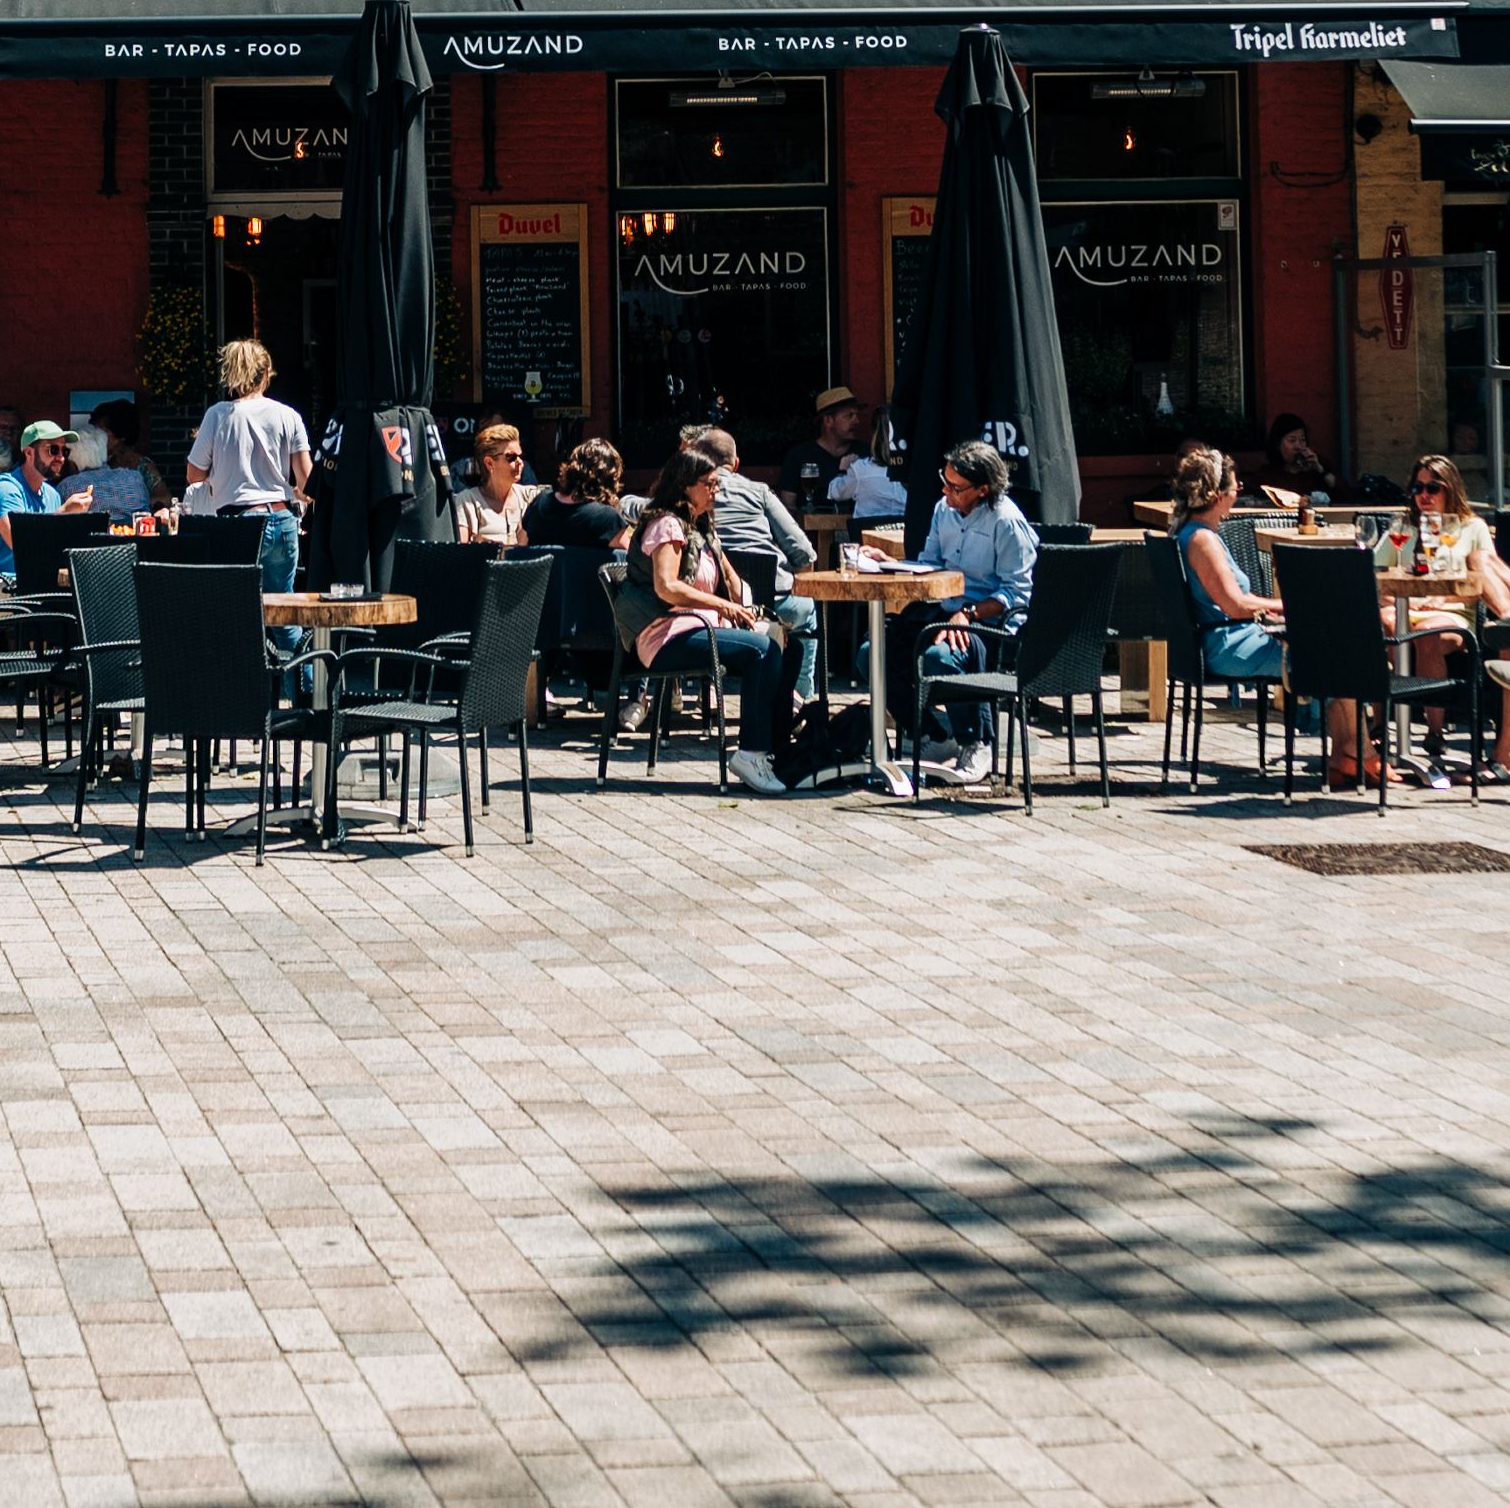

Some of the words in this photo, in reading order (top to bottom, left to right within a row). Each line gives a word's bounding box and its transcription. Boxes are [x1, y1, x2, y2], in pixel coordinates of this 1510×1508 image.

[104, 43, 144, 57] BAR
[164, 43, 227, 57] TAPAS
[247, 42, 302, 56] FOOD
[443, 35, 584, 69] AMUZAND
[718, 37, 756, 51] BAR
[775, 36, 835, 51] TAPAS
[855, 35, 907, 49] FOOD
[1229, 22, 1295, 58] Tripel
[1299, 21, 1407, 50] Karmeliet
[231, 127, 348, 161] AMUZAN
[498, 212, 561, 235] Duvel
[635, 251, 807, 295] AMUZAND
[1054, 244, 1223, 286] AMUZAND
[712, 283, 733, 292] BAR
[741, 283, 771, 291] TAPAS
[779, 281, 808, 291] FOOD
[1158, 275, 1188, 286] TAPAS
[1196, 273, 1223, 286] FOOD
